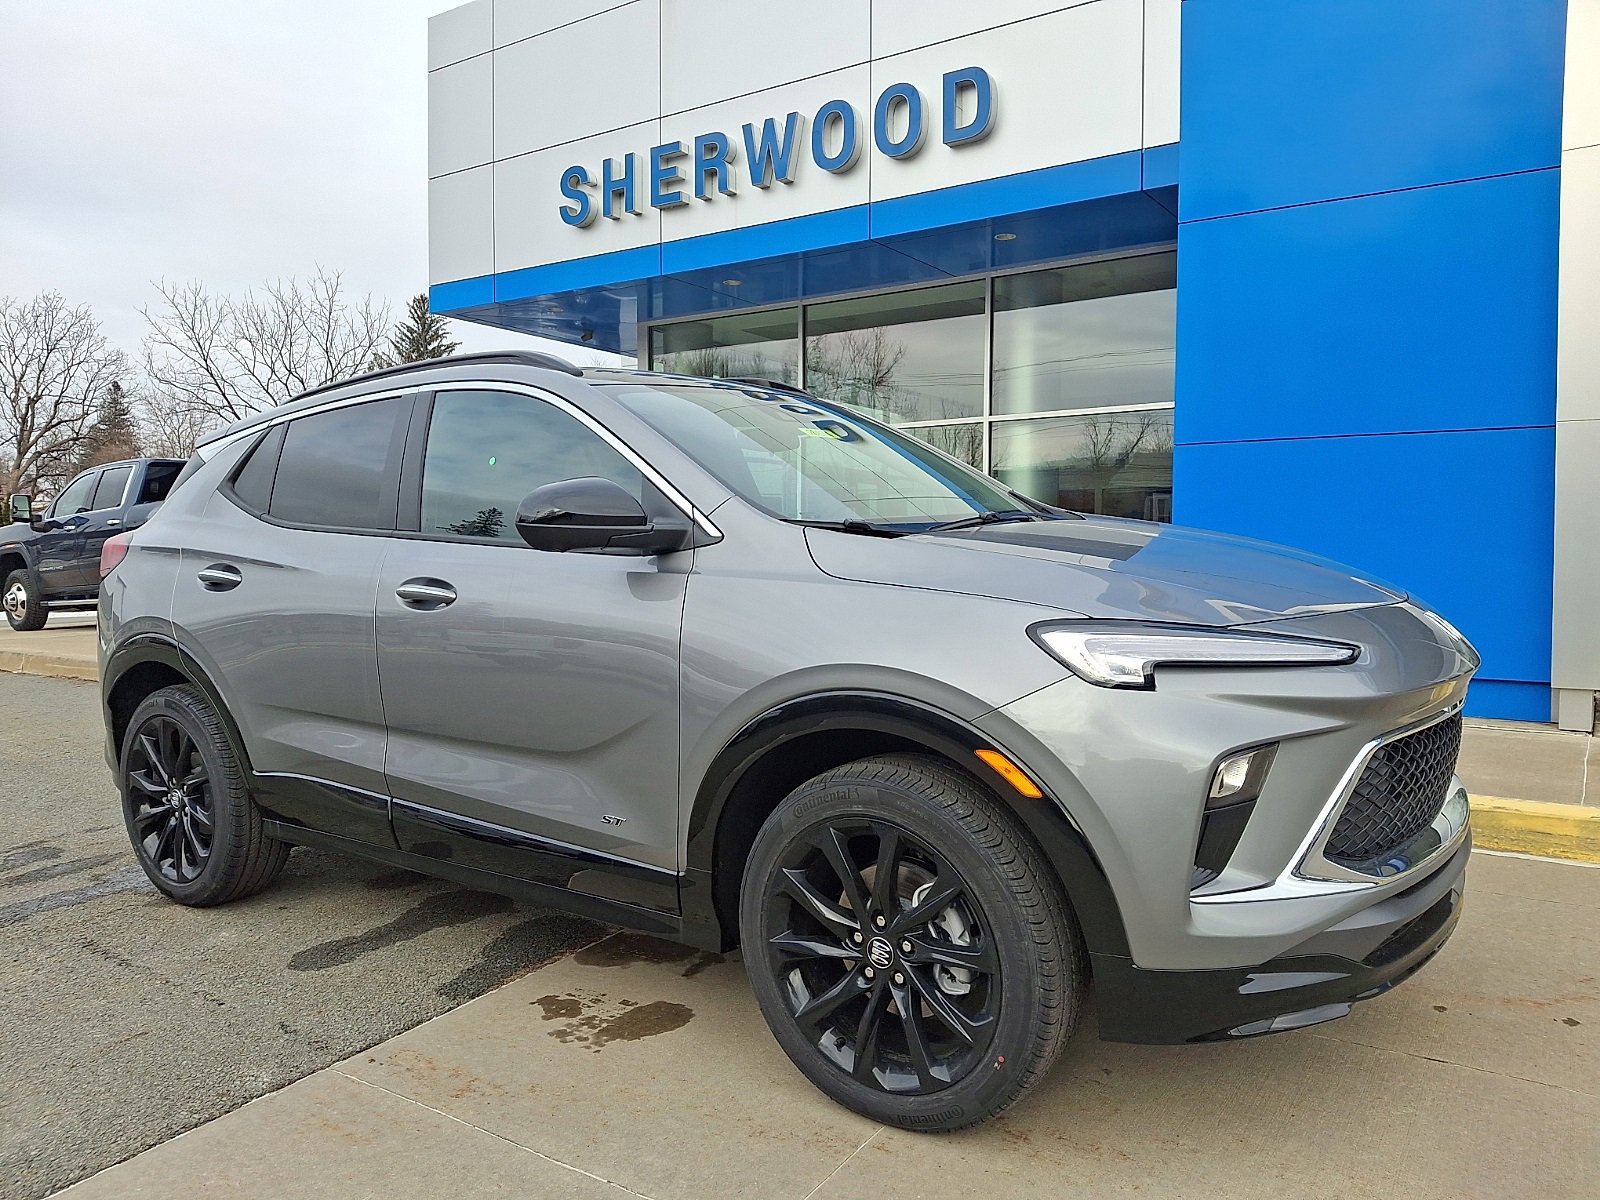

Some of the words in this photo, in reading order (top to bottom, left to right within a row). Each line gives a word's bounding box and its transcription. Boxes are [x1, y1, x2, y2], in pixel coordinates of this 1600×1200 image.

[559, 66, 998, 228] SHERWOOD
[793, 787, 851, 818] Continental
[600, 814, 627, 827] ST
